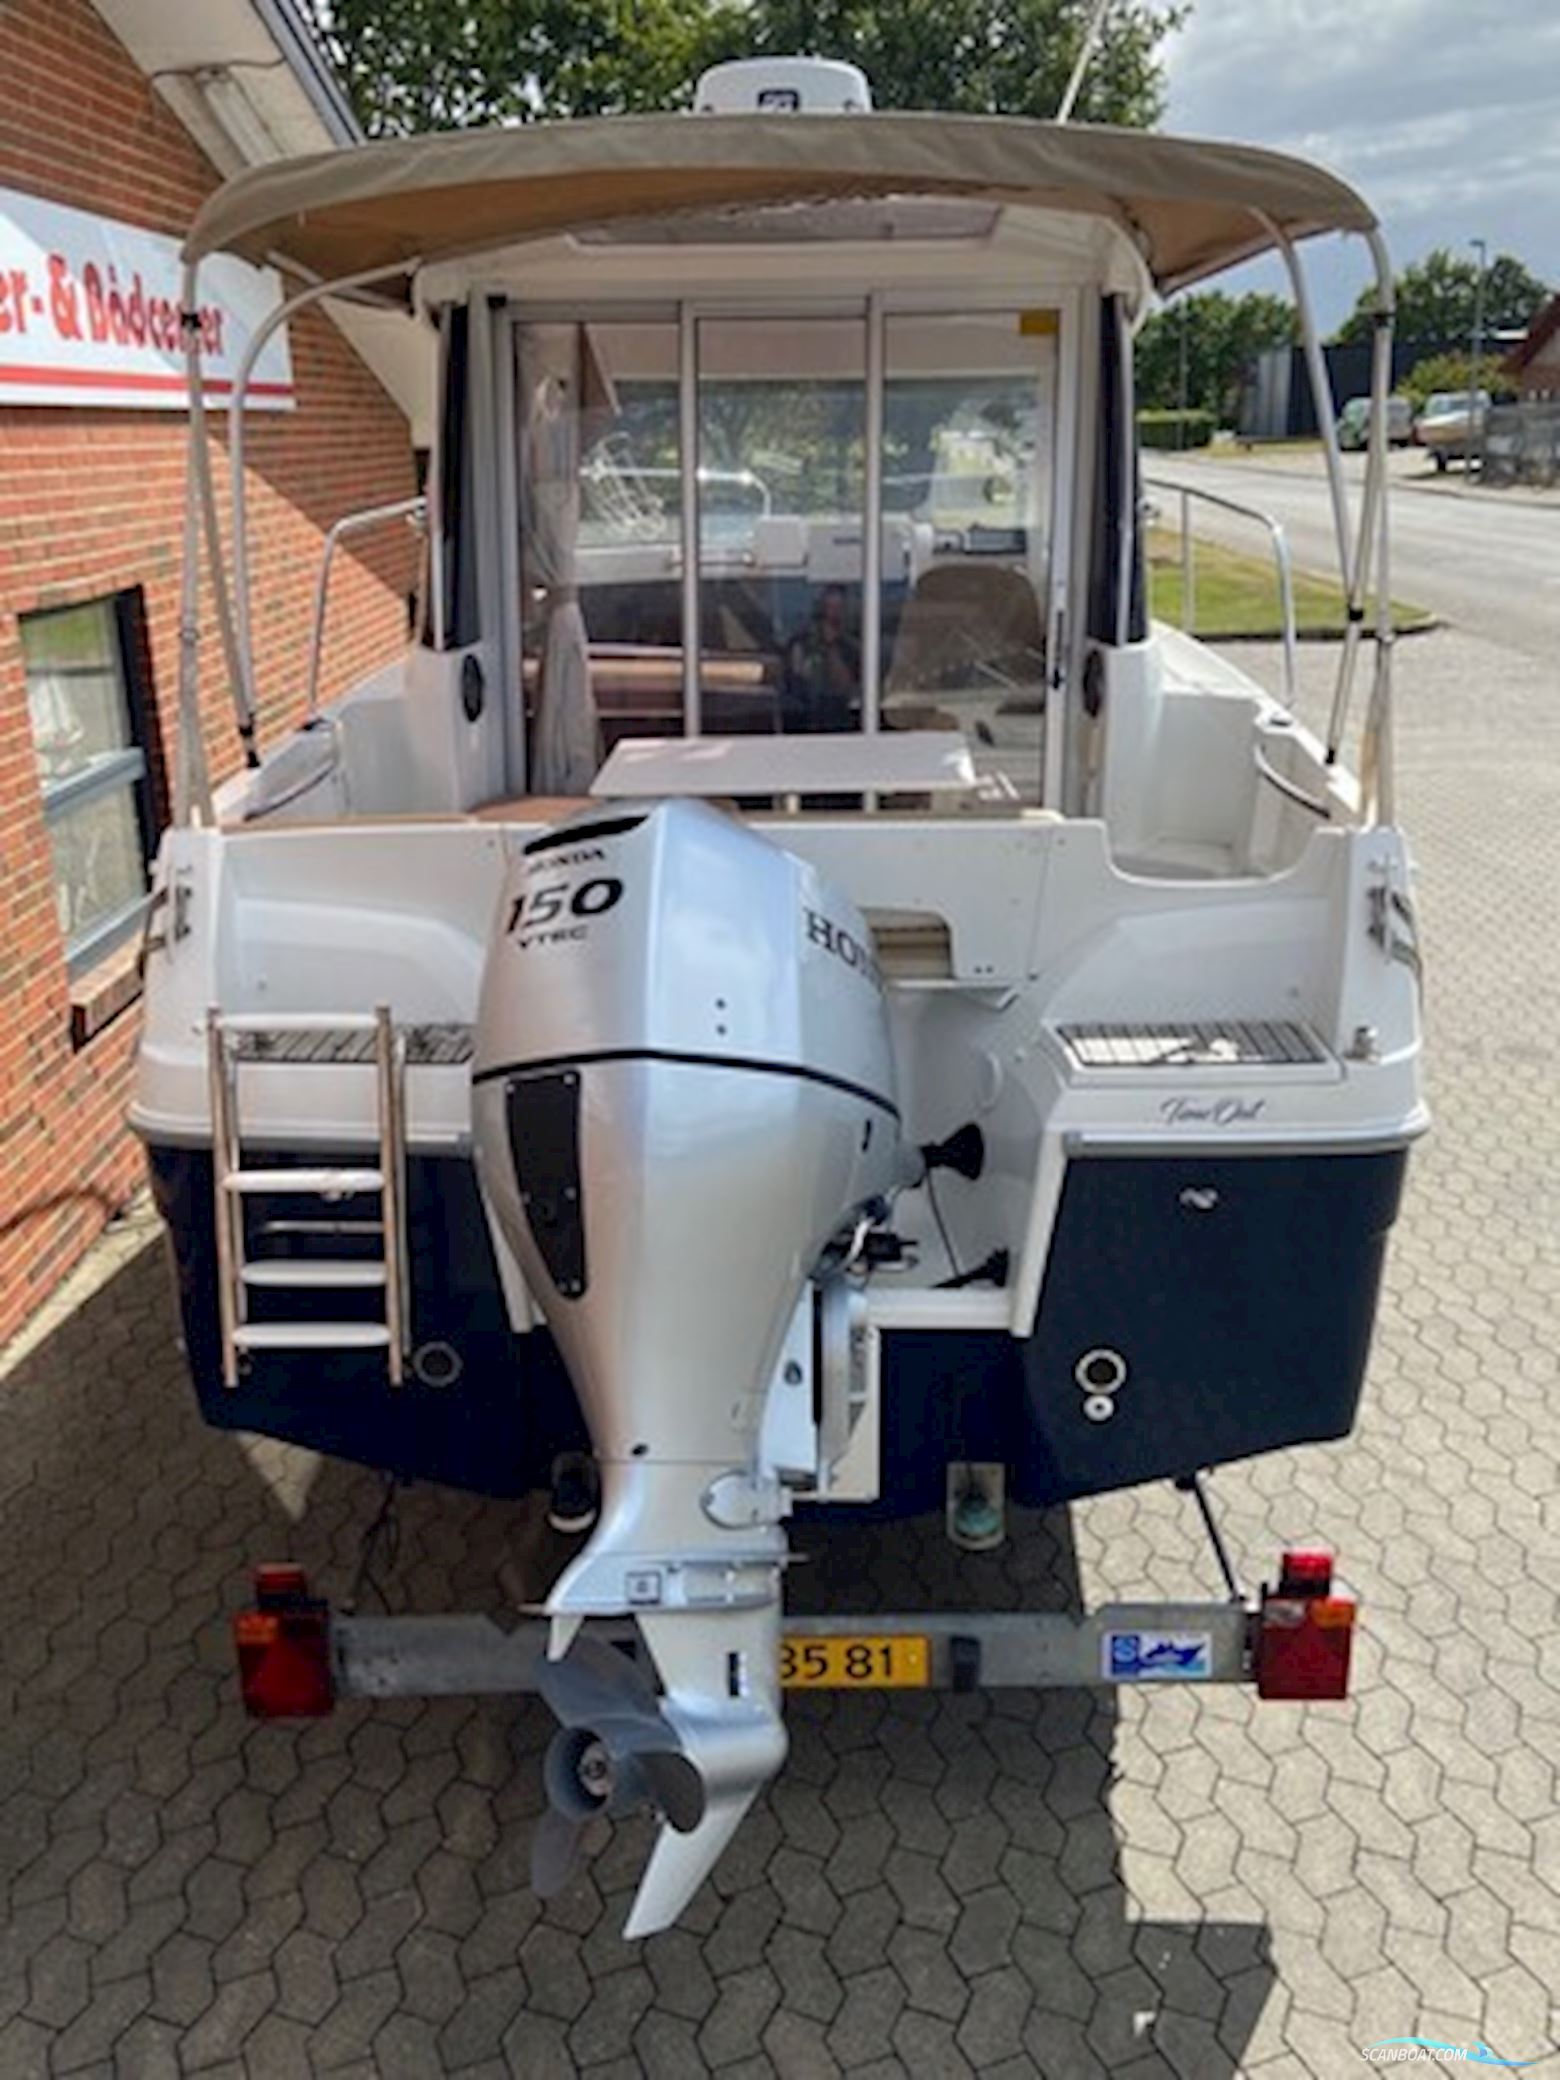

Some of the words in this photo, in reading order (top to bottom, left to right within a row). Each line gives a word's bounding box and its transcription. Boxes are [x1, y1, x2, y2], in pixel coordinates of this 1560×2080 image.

[506, 876, 625, 934] 150
[518, 924, 589, 949] VTEC
[846, 1644, 893, 1680] 81
